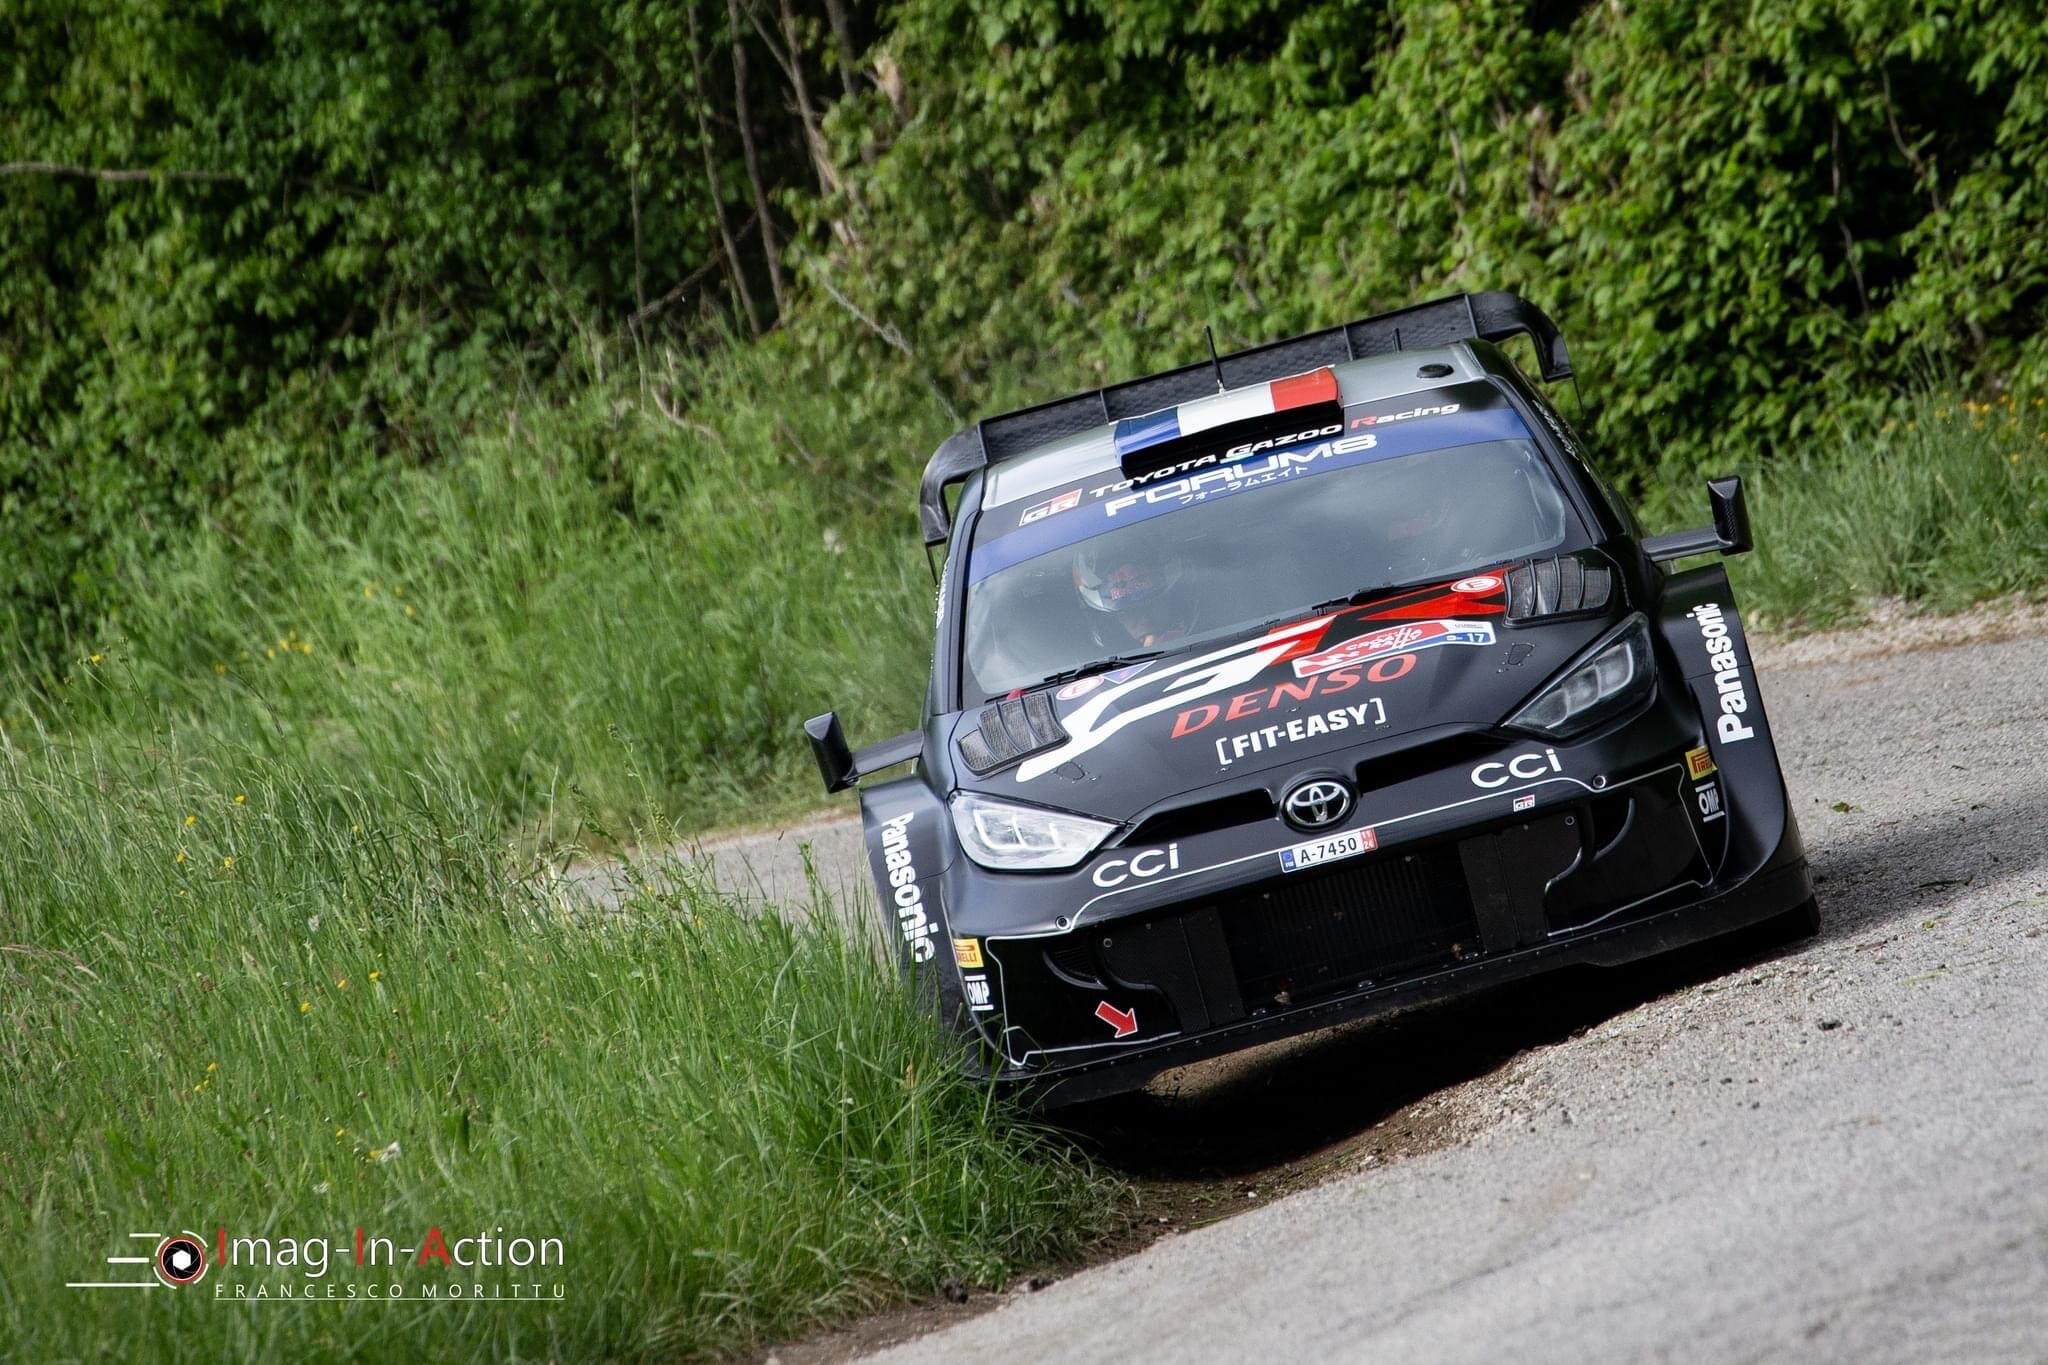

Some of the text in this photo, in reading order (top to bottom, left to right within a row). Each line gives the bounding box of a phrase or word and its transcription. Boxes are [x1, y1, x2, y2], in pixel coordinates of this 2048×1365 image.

[1089, 403, 1461, 498] TOYOTA GAZOO Racing
[1104, 433, 1378, 518] FORUM8
[1178, 465, 1309, 505] フォーラムエイト
[1021, 493, 1080, 524] GR
[1466, 632, 1485, 643] 17
[1685, 602, 1755, 745] Panasonic
[1170, 653, 1417, 739] DENSO
[1215, 697, 1387, 766] [FIT-EASY]
[1691, 752, 1714, 777] PIRE
[1300, 837, 1357, 864] A-7450
[876, 811, 940, 963] Panasonic
[953, 944, 978, 964] PRELLI
[966, 981, 990, 1007] OMP
